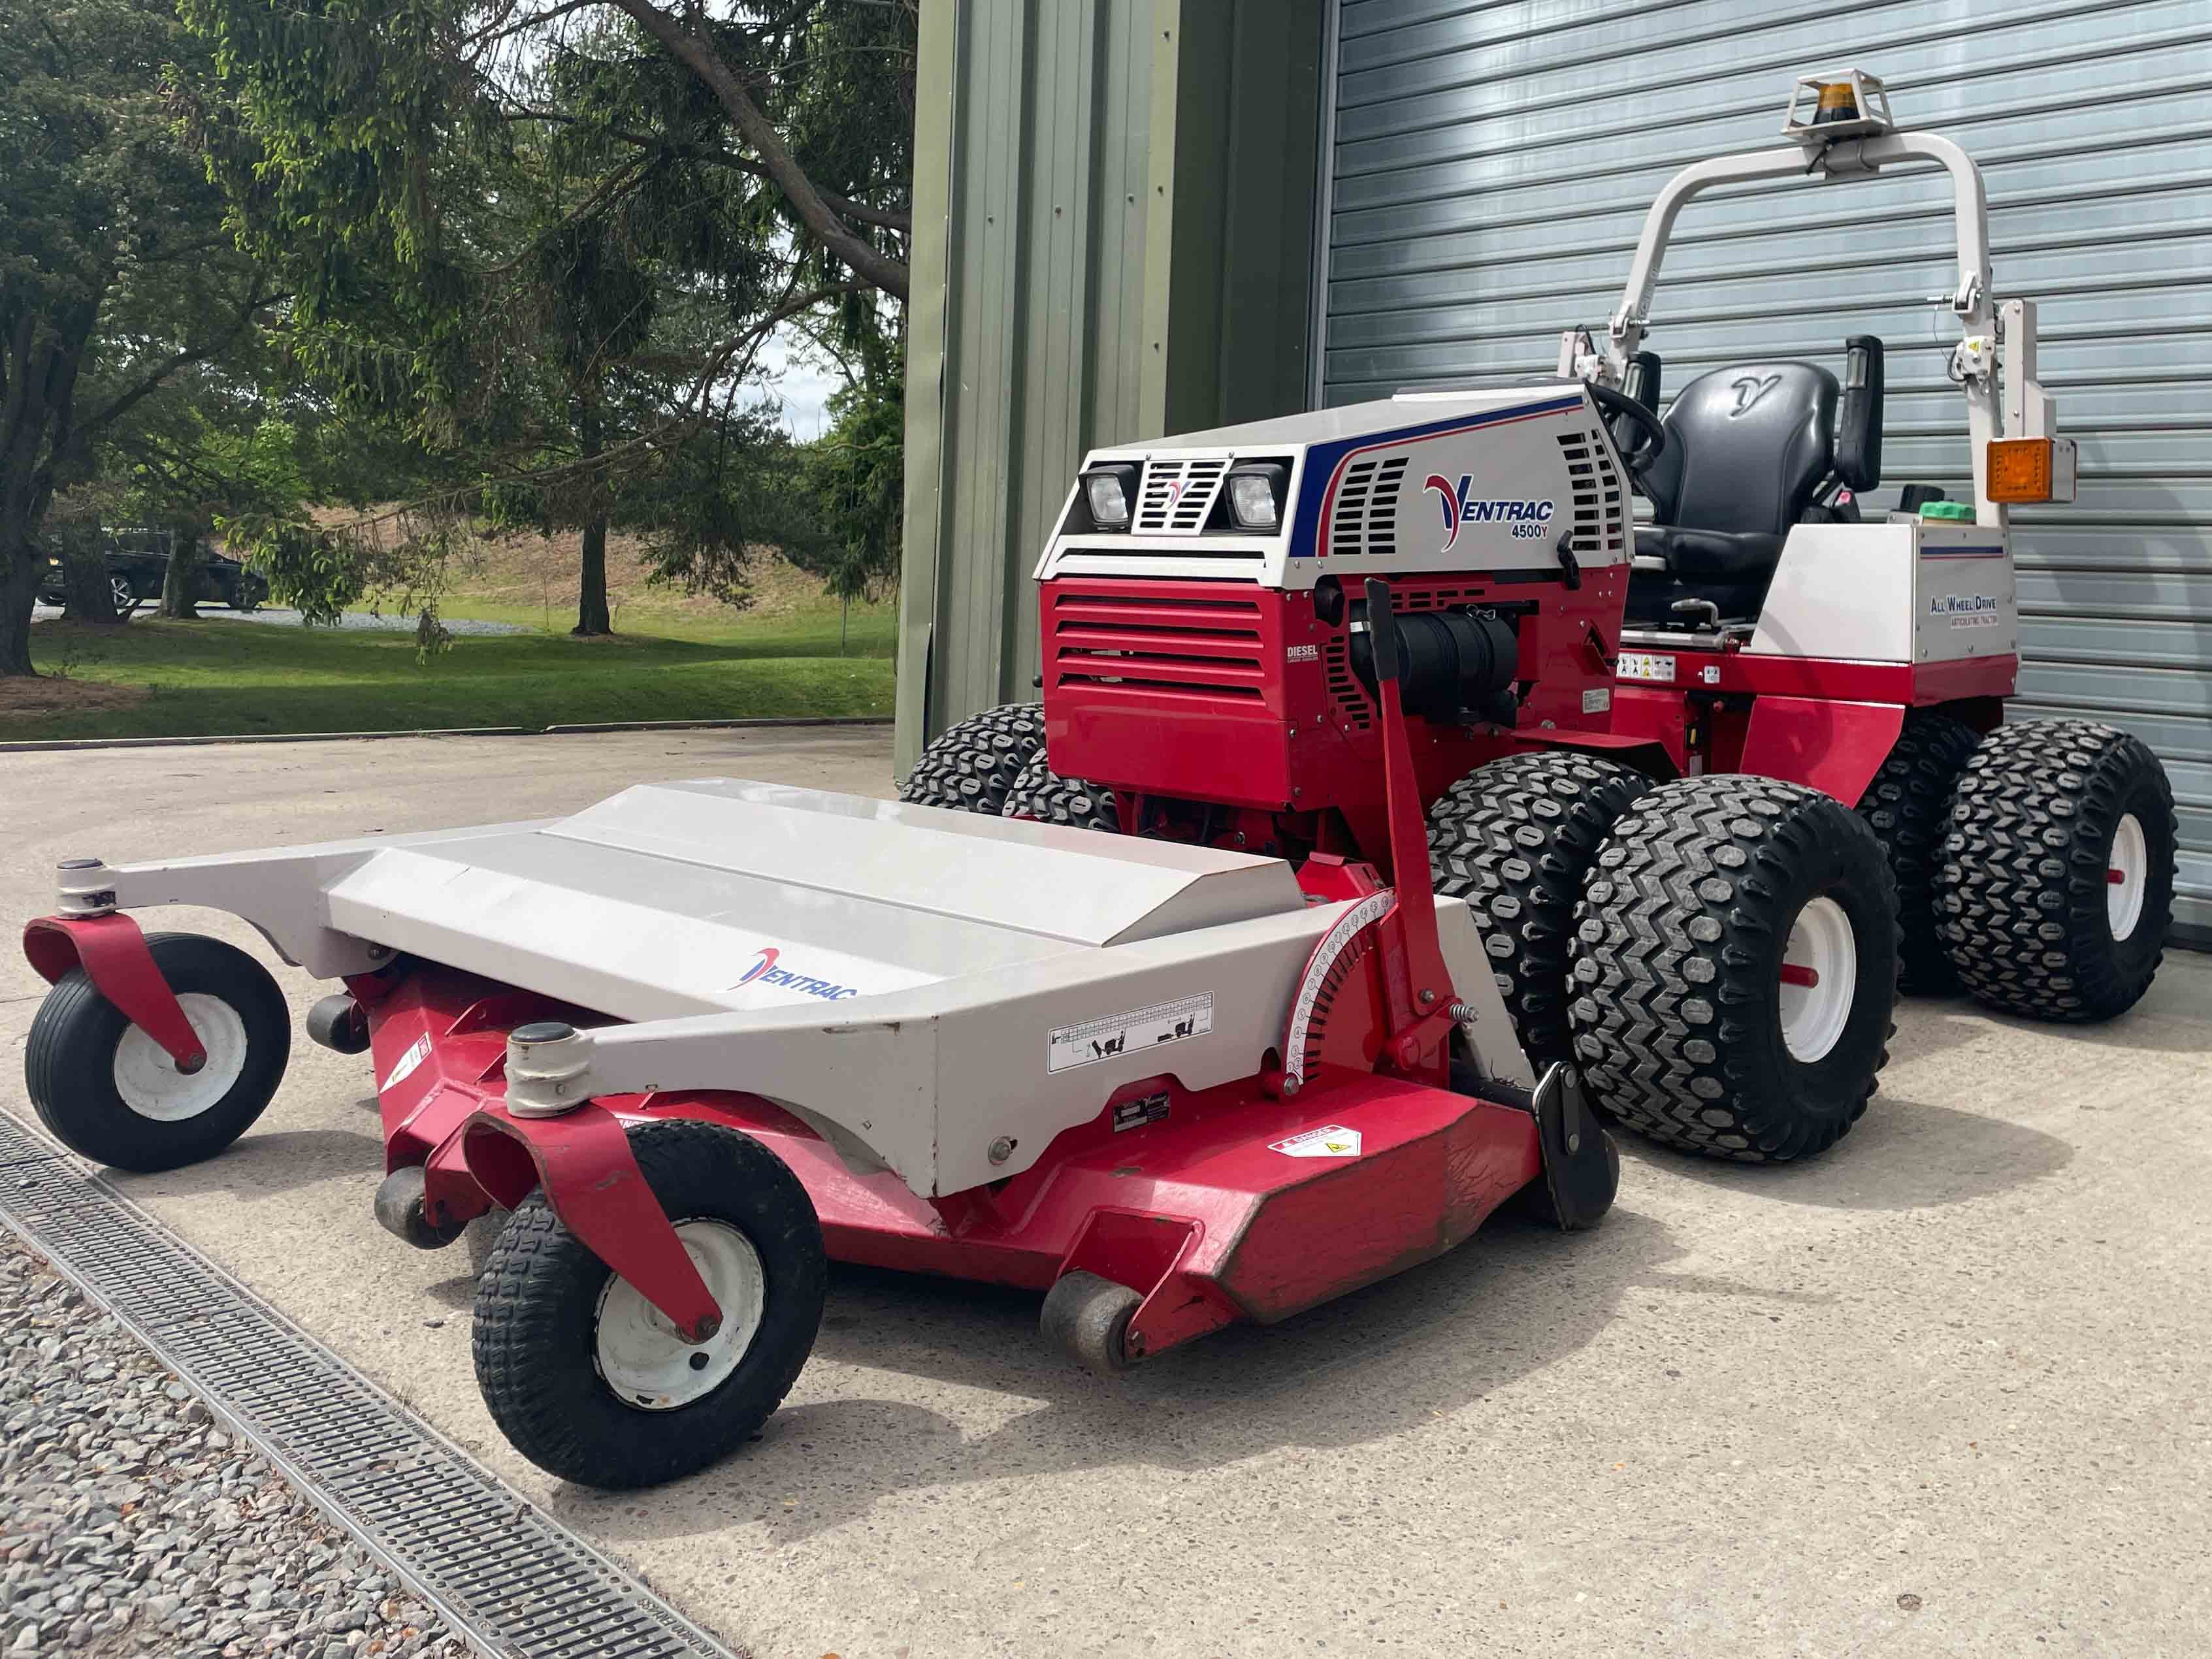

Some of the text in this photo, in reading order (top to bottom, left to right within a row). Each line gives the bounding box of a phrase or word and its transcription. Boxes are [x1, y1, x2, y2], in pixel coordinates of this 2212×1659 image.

[1423, 474, 1553, 553] VENTRAC
[1511, 524, 1548, 538] 4500Y
[1930, 595, 1996, 613] ALL WHEEL DRIVE
[1287, 645, 1318, 657] DIESEL
[726, 948, 858, 1001] VENTRAC
[1293, 1127, 1334, 1143] DANGER
